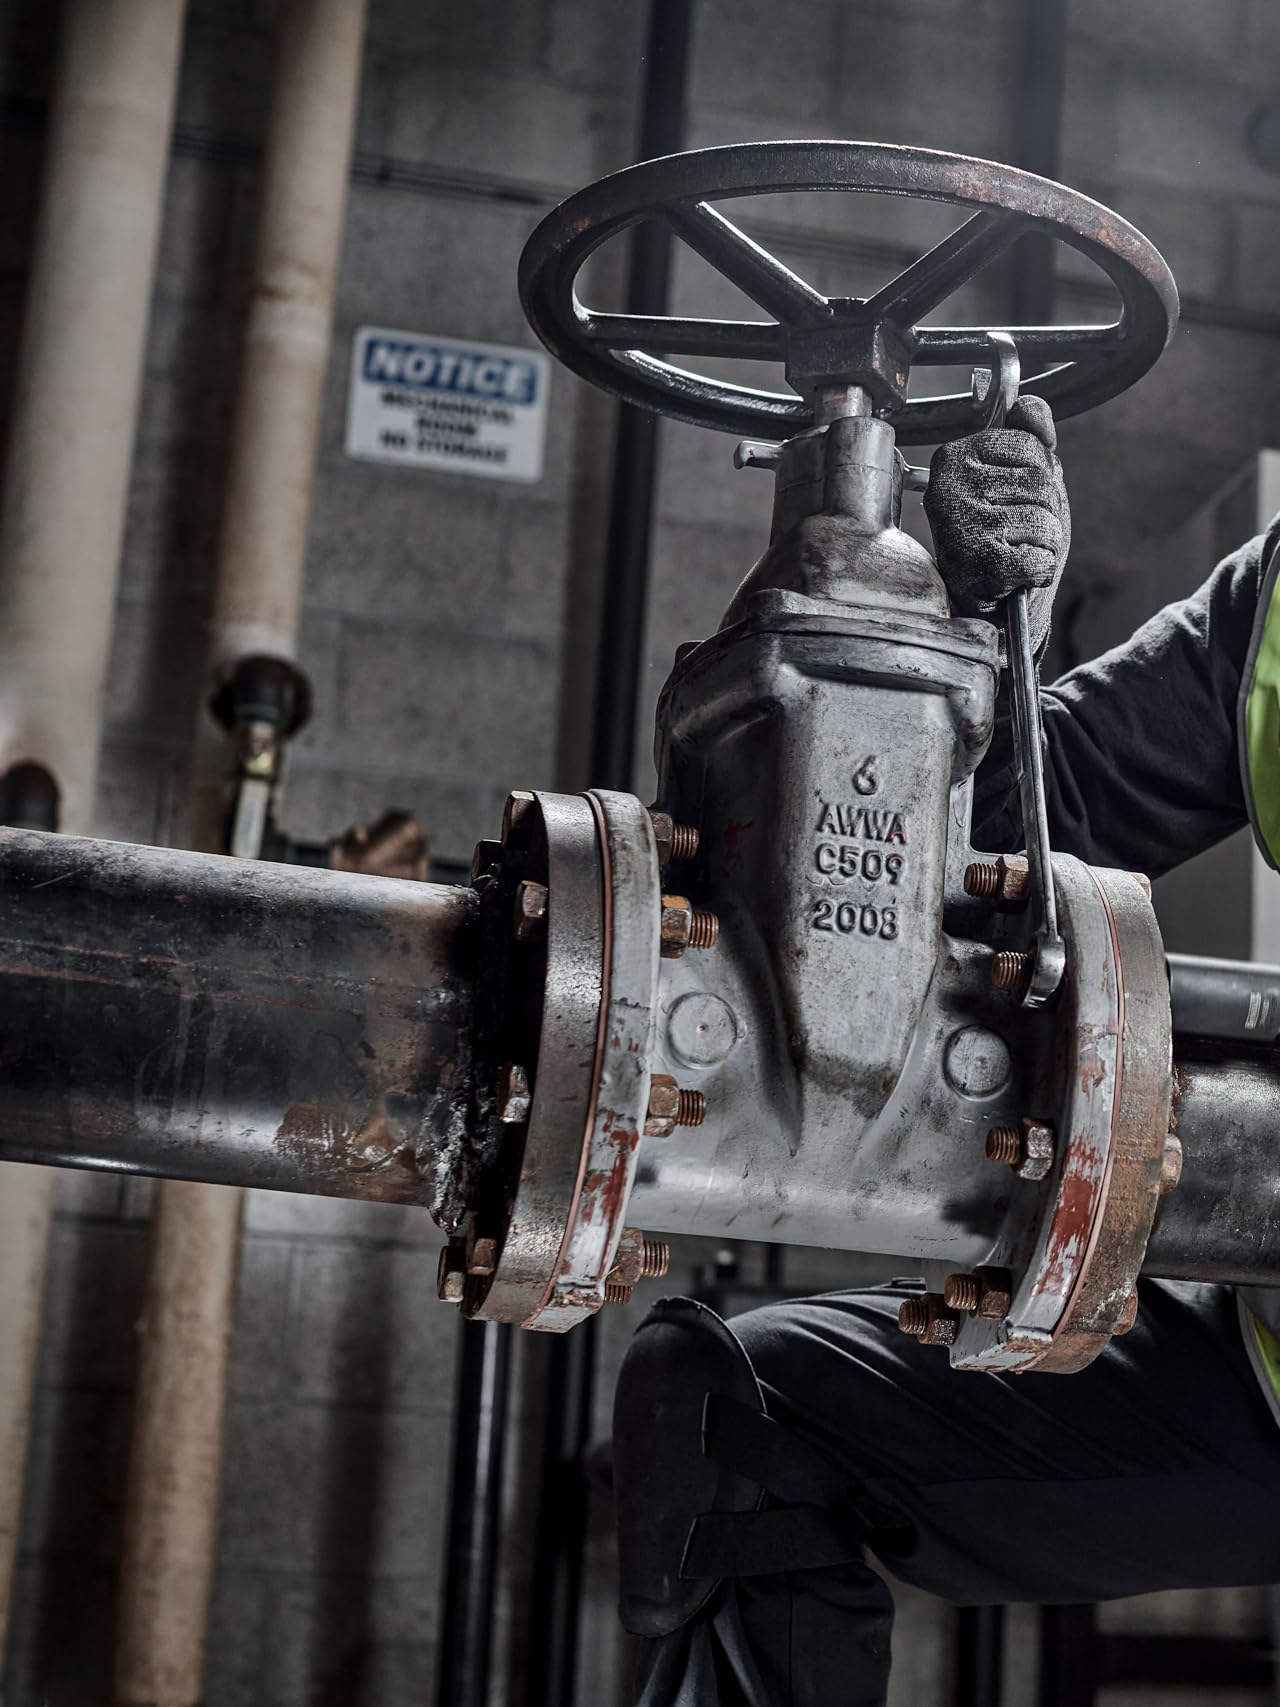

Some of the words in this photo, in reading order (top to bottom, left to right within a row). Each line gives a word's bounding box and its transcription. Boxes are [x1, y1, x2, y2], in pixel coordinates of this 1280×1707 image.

[368, 346, 530, 396] NOTICE
[852, 755, 879, 796] 6
[815, 803, 907, 845] AWWA
[815, 843, 905, 885] C509
[812, 900, 899, 940] 2008
